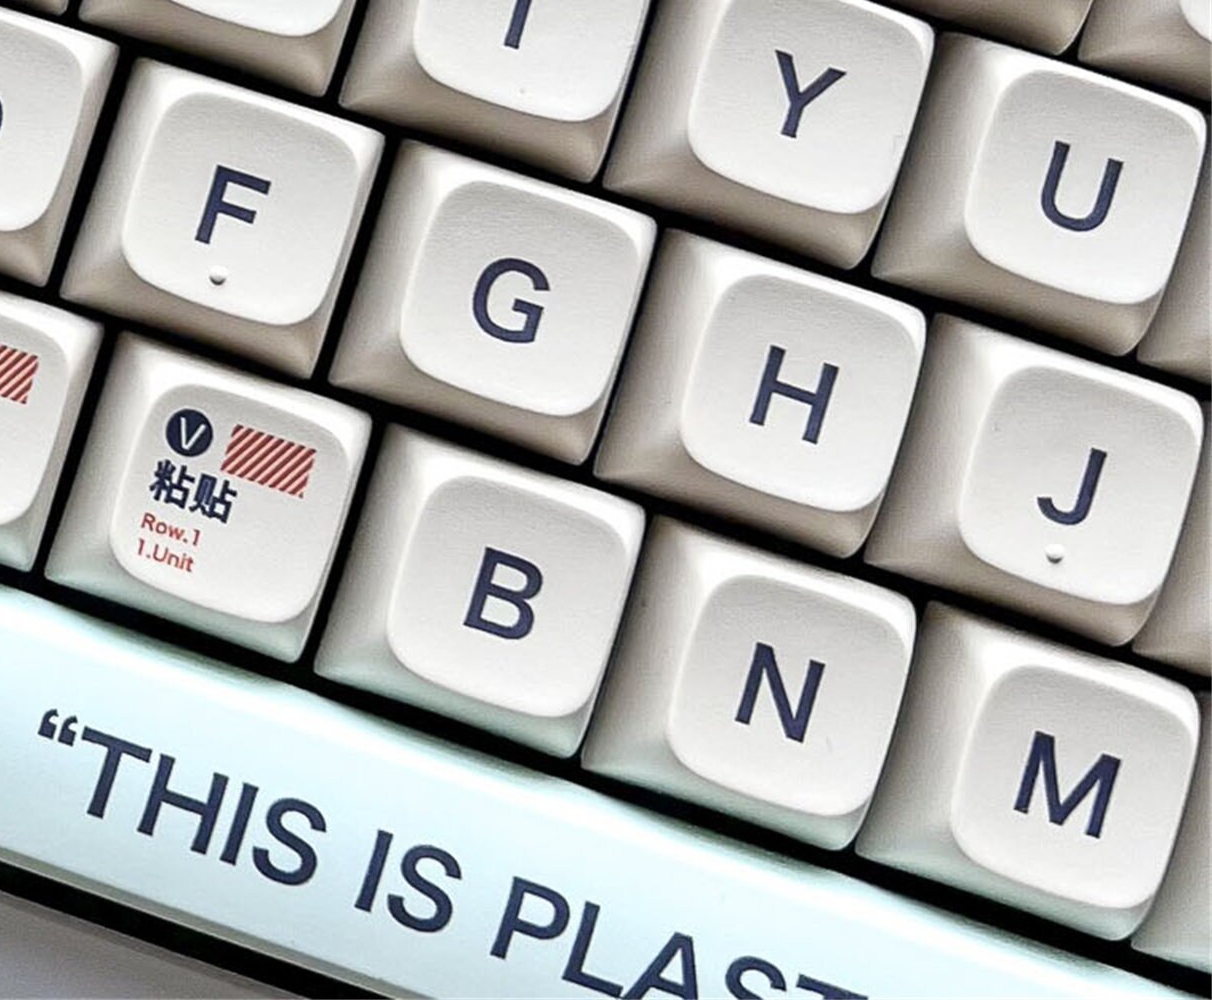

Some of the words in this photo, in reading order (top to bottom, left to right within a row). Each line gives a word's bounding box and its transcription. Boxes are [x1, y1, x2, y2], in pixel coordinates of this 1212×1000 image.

[776, 50, 846, 138] Y
[195, 165, 271, 244] F
[1042, 141, 1123, 231] U
[473, 258, 549, 343] G
[750, 346, 839, 444] H
[141, 512, 201, 546] Row.1
[149, 459, 238, 524] 粘贴
[1038, 448, 1107, 525] J
[137, 538, 194, 572] 1.Unit
[464, 547, 542, 639] B
[735, 643, 825, 742] N
[1014, 731, 1121, 838] M
[355, 830, 461, 932] IS
